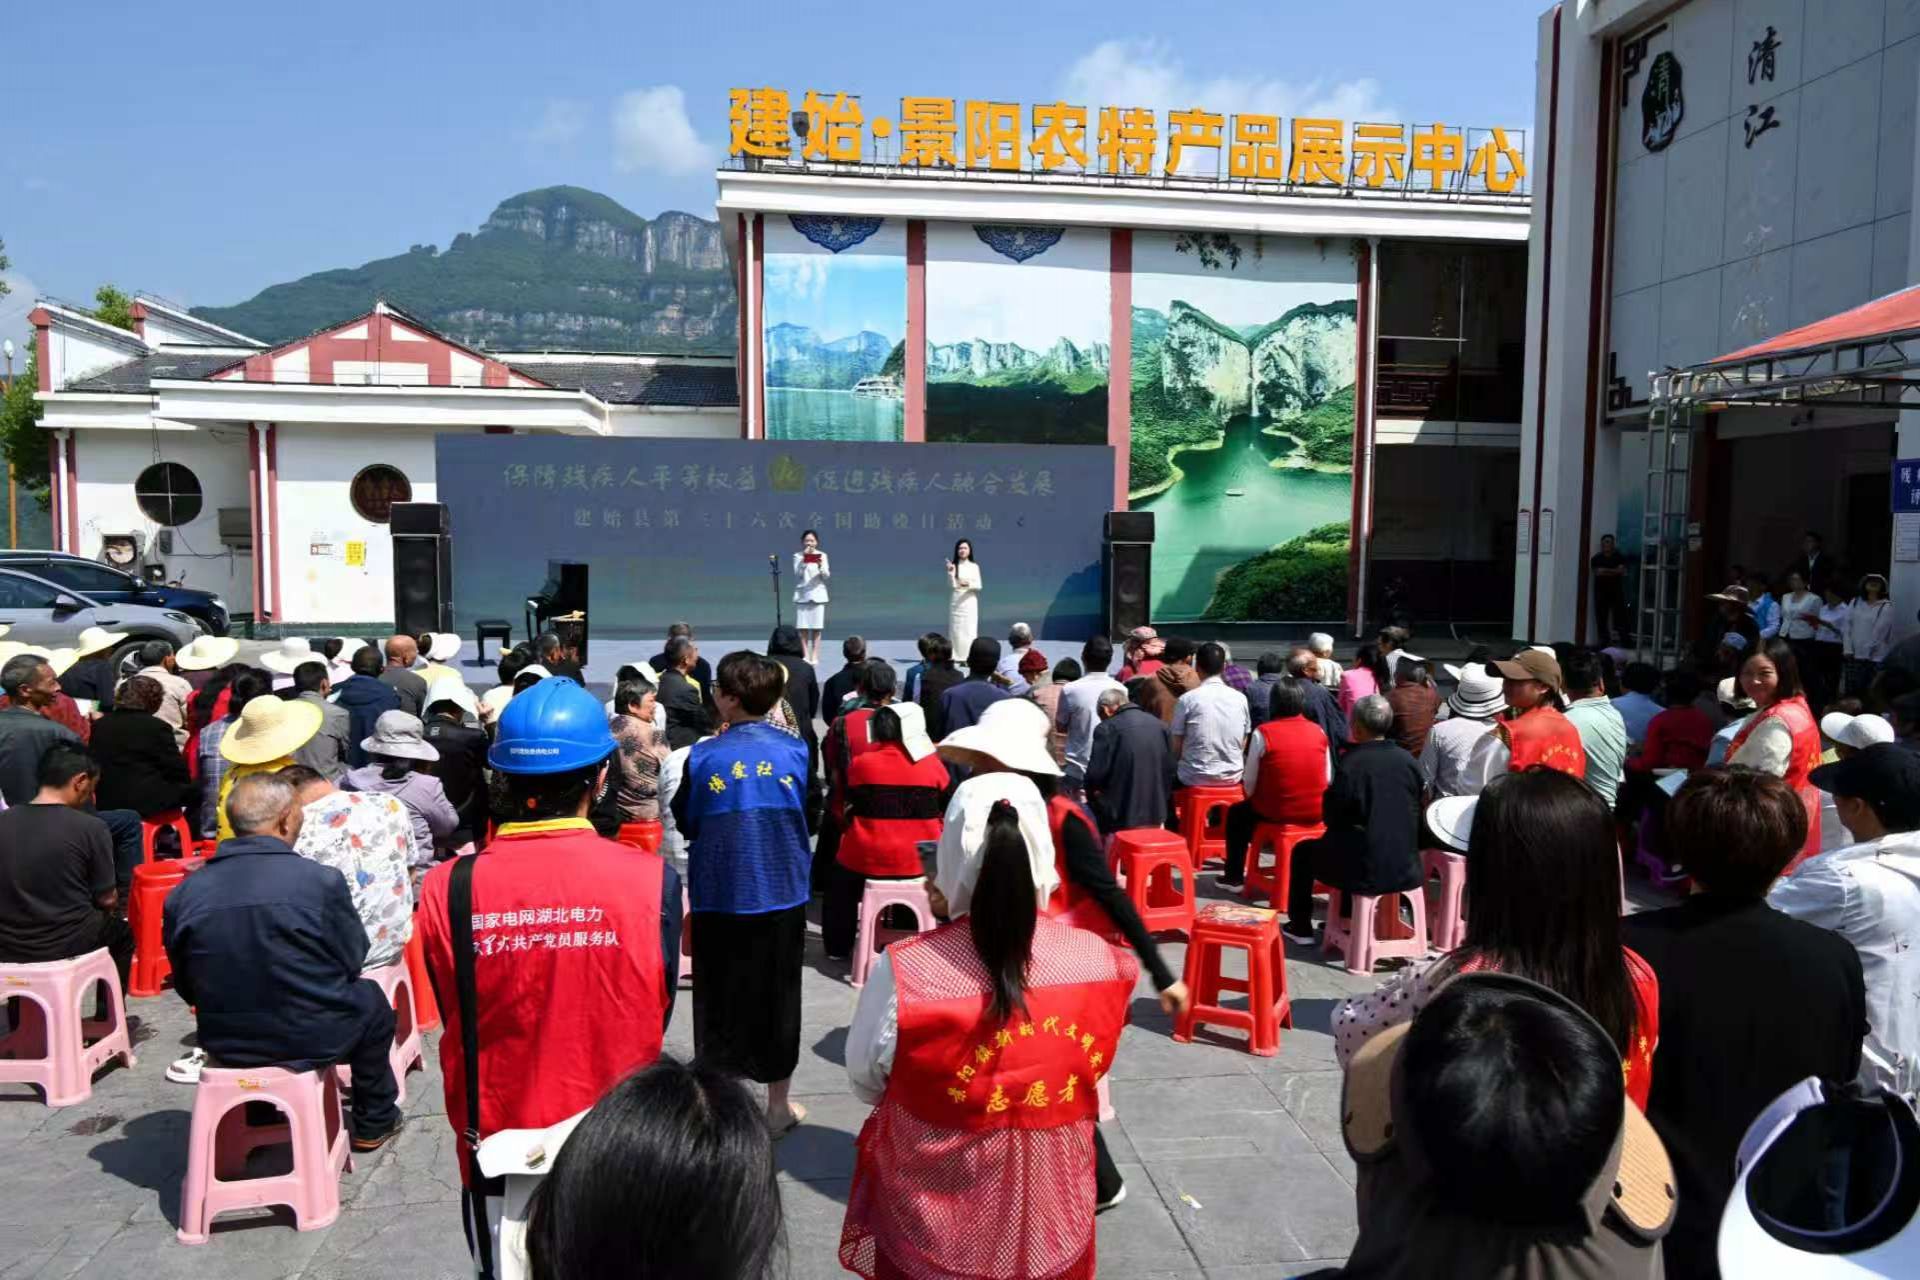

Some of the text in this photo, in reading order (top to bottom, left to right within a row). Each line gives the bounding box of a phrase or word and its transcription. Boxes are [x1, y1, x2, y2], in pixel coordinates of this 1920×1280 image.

[1744, 25, 1782, 149] 清江
[503, 463, 1056, 496] 保障残疾人平等权益 促进残疾人融合发展
[986, 1074, 1080, 1113] 志愿者
